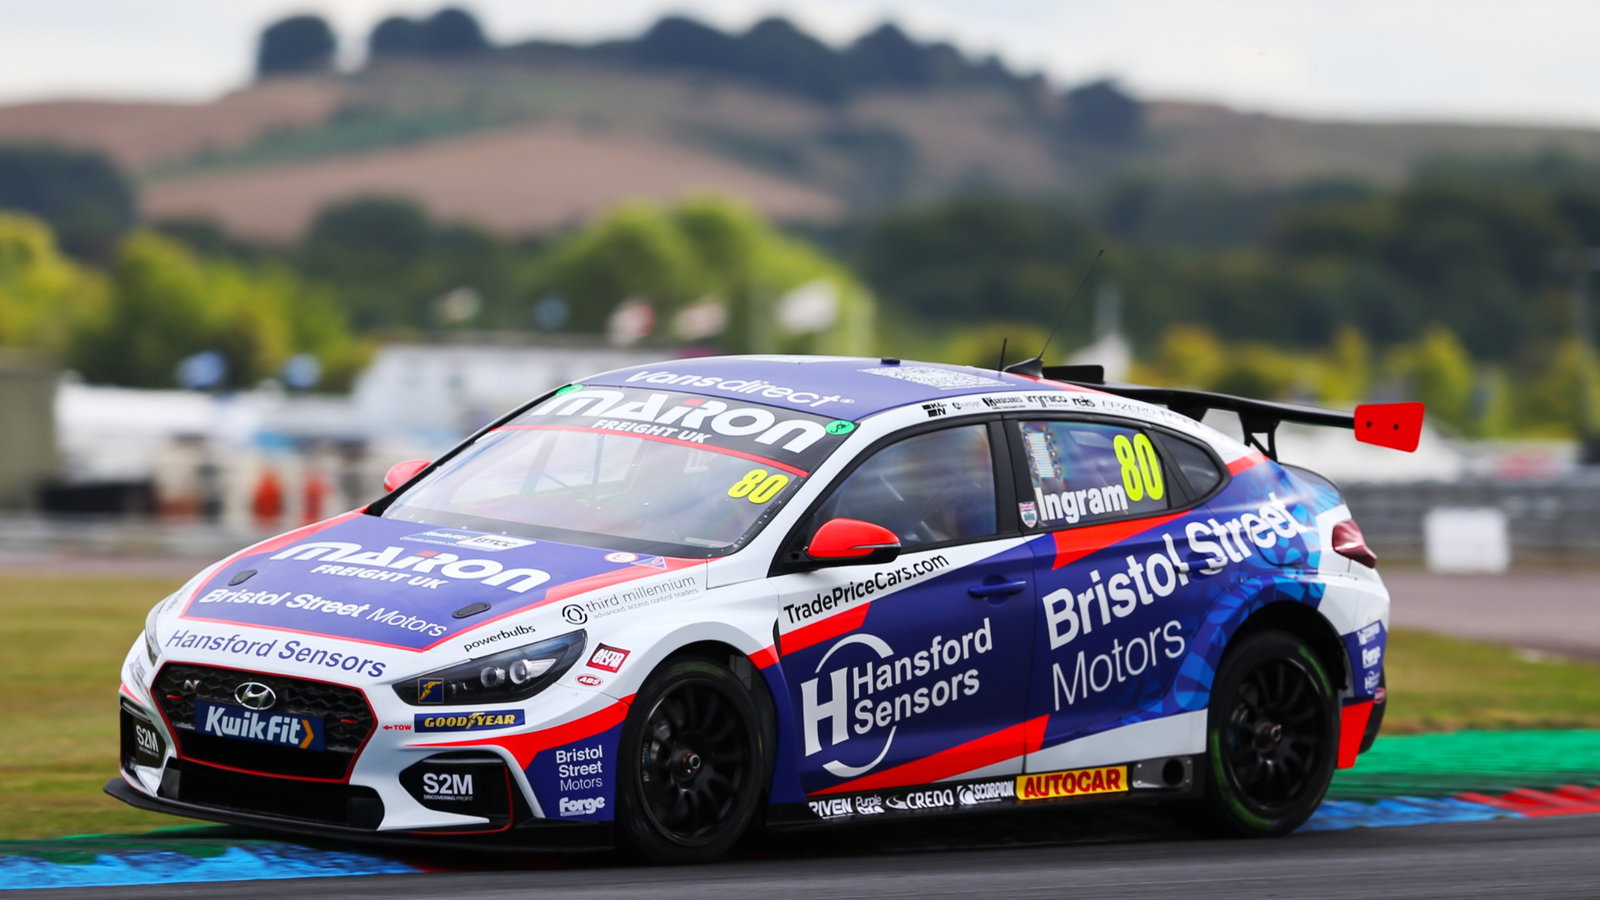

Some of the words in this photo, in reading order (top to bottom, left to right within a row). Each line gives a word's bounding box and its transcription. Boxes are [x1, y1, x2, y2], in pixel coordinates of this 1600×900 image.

[591, 419, 679, 438] FREIGHT
[677, 429, 712, 444] UK
[1113, 433, 1164, 502] 80
[728, 469, 789, 504] 80
[1034, 484, 1128, 524] Ingram
[310, 564, 410, 582] FREIGHT
[407, 575, 449, 590] UK
[1042, 533, 1189, 650] Bristol
[1185, 492, 1307, 576] Street
[586, 595, 619, 613] third
[623, 576, 696, 602] millennium
[783, 554, 949, 624] TradePriceCars.com
[198, 589, 288, 606] Bristol
[286, 593, 370, 618] Street
[366, 607, 448, 637] Motors
[463, 625, 536, 653] powerbulbs
[164, 629, 278, 658] Hansford
[278, 640, 386, 678] Sensors
[853, 617, 992, 699] Hansford
[1052, 619, 1185, 711] Motors
[854, 669, 980, 735] Sensors
[424, 713, 516, 728] GOODYEAR
[136, 725, 159, 752] S2M
[556, 745, 603, 764] Bristol
[558, 761, 603, 778] Street
[1023, 769, 1121, 798] AUTOCAR
[423, 773, 473, 795] S2M
[560, 777, 603, 792] Motors
[974, 780, 1014, 799] SCORPION
[559, 797, 605, 814] Forge
[906, 789, 954, 809] CREDO
